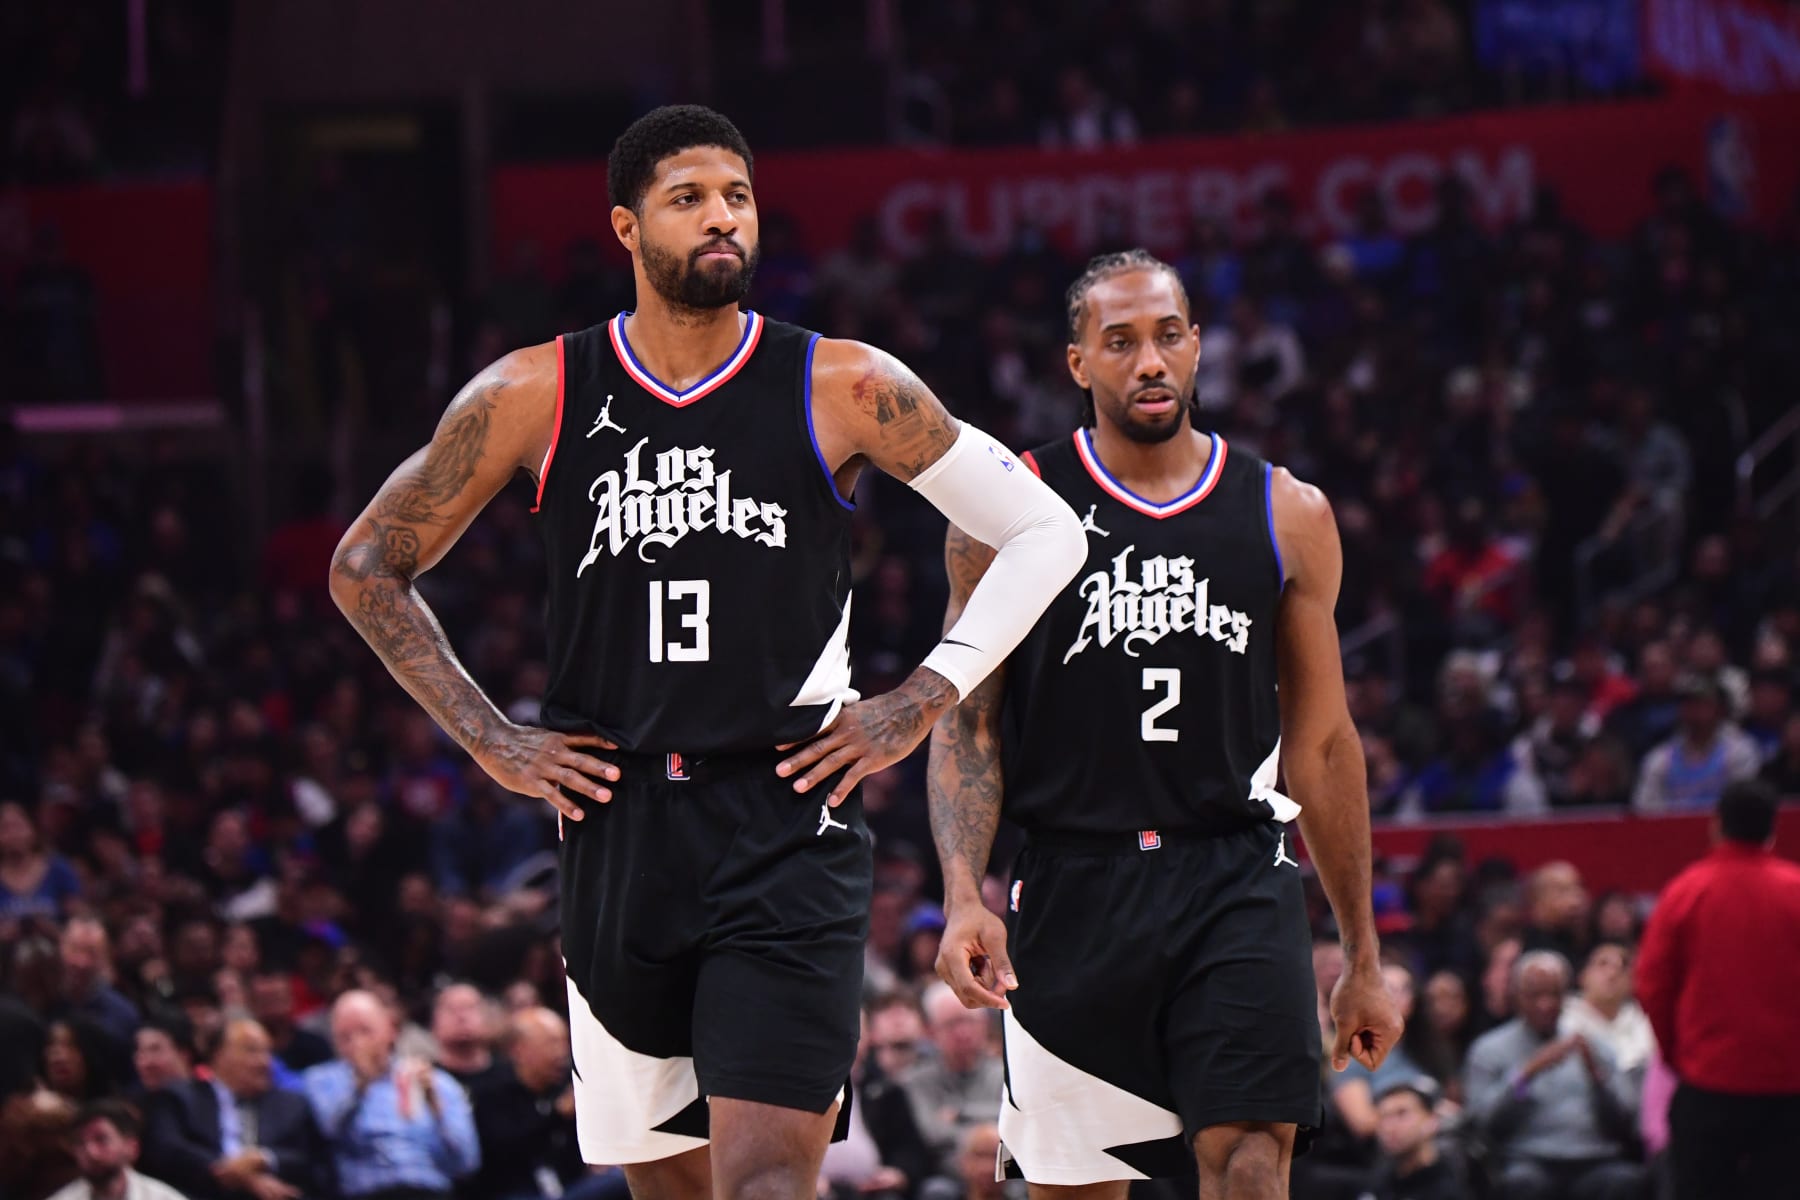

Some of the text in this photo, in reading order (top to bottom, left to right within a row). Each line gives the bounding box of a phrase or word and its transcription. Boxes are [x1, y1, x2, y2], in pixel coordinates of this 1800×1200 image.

[621, 437, 716, 498] Los
[577, 470, 788, 579] Angeles
[1109, 544, 1195, 597] Los
[649, 579, 710, 663] 13
[1062, 571, 1252, 665] Angeles
[1141, 667, 1181, 742] 2
